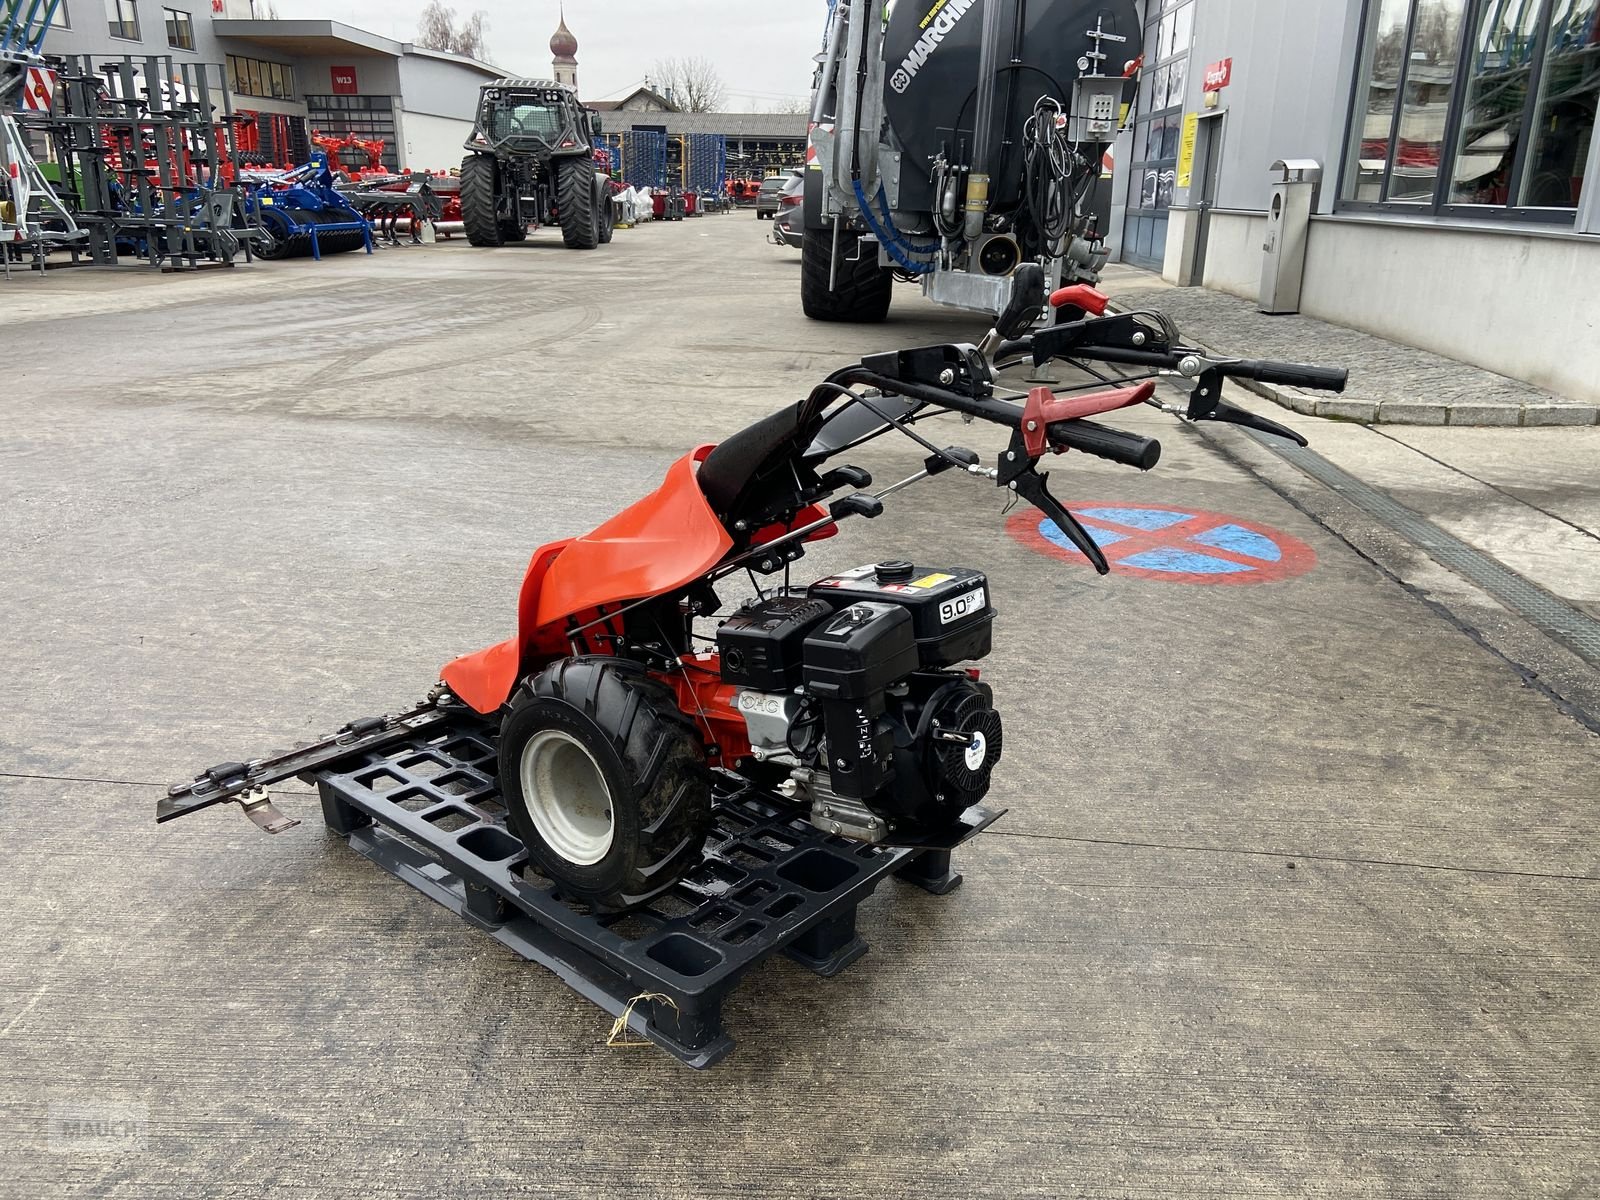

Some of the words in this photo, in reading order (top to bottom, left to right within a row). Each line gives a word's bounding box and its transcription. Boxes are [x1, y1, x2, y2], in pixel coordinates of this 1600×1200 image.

[336, 76, 352, 84] W13
[942, 599, 966, 620] 9.0
[741, 694, 780, 714] OHC
